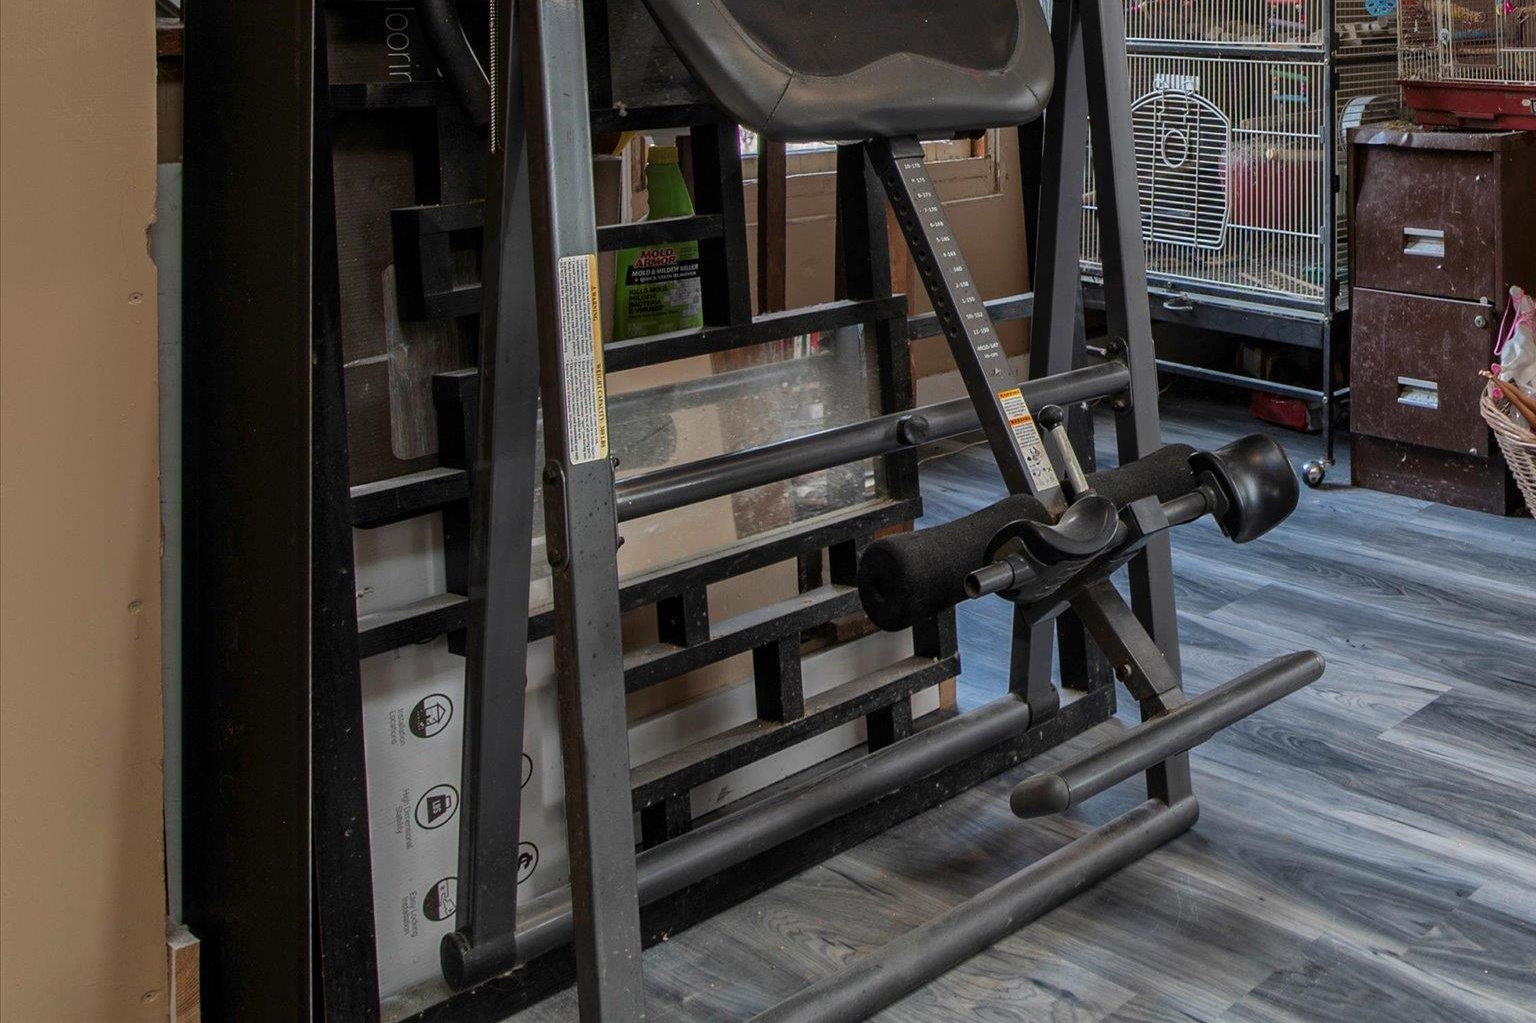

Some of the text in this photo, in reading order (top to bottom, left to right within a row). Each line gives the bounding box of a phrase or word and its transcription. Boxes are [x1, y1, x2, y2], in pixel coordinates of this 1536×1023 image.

[641, 248, 674, 258] MOLD
[634, 256, 676, 268] ARMOR
[595, 363, 603, 389] WEIGHT
